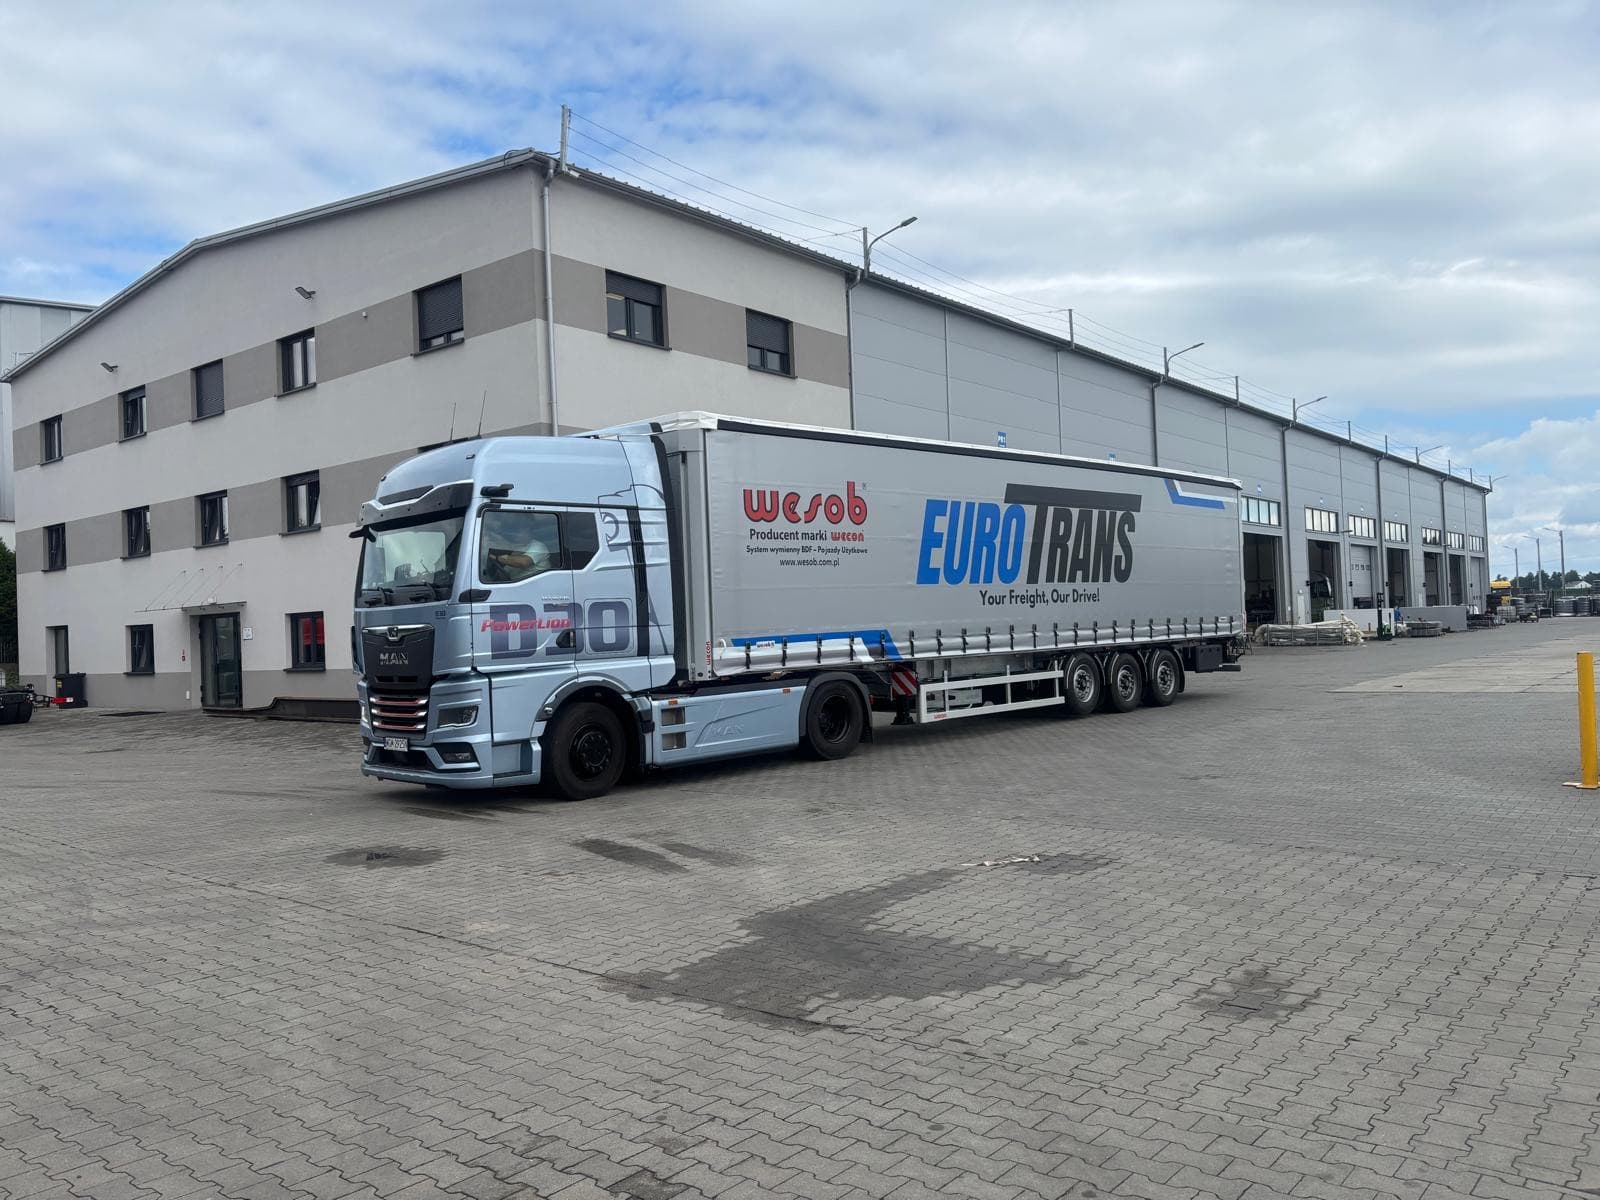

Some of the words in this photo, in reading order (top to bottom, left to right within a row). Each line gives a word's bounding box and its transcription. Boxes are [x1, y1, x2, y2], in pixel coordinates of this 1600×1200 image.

[743, 481, 867, 525] wesob
[749, 528, 799, 541] Producent
[801, 530, 827, 541] marki
[830, 530, 864, 542] wecon
[916, 483, 1142, 585] EUROTRANS
[746, 545, 768, 555] System
[769, 546, 800, 555] wymienny
[817, 546, 840, 555] Pojazdy
[779, 557, 840, 567] www.wesob.com.pl
[979, 590, 1006, 605] Your
[1009, 589, 1049, 608] Freight,
[1051, 589, 1070, 603] Our
[1072, 588, 1101, 602] Drive!
[379, 652, 409, 665] MAN
